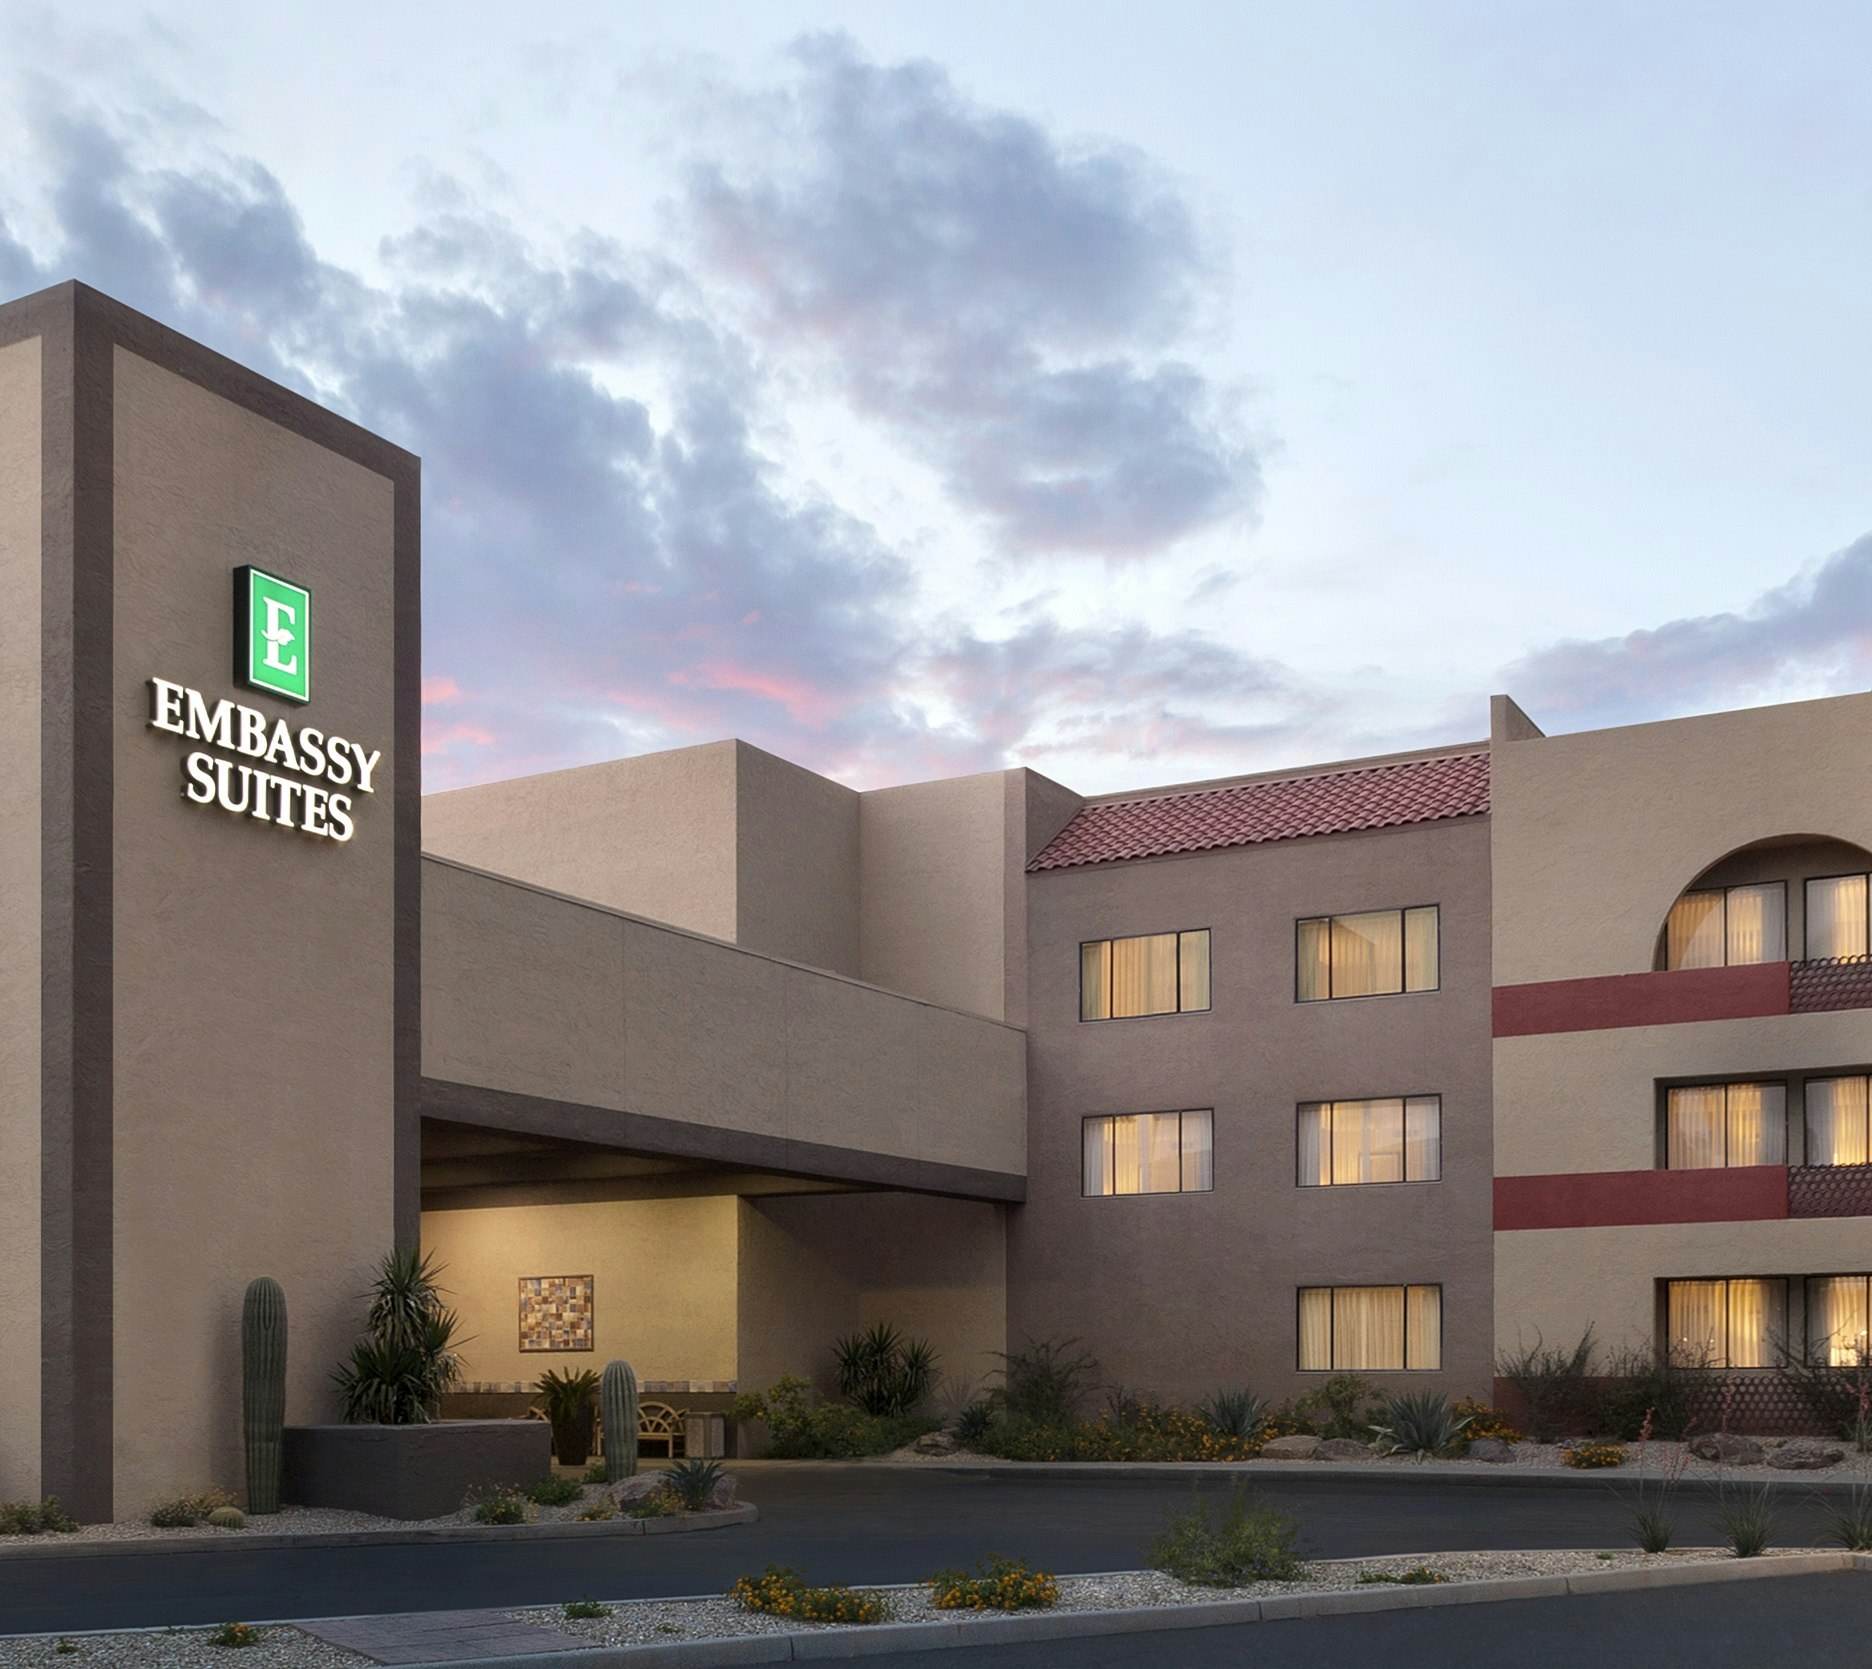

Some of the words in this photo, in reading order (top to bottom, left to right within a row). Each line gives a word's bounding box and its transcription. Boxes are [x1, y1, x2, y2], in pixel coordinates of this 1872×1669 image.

[261, 596, 297, 676] E
[151, 677, 381, 793] EMBASSY
[186, 752, 354, 842] SUITES
